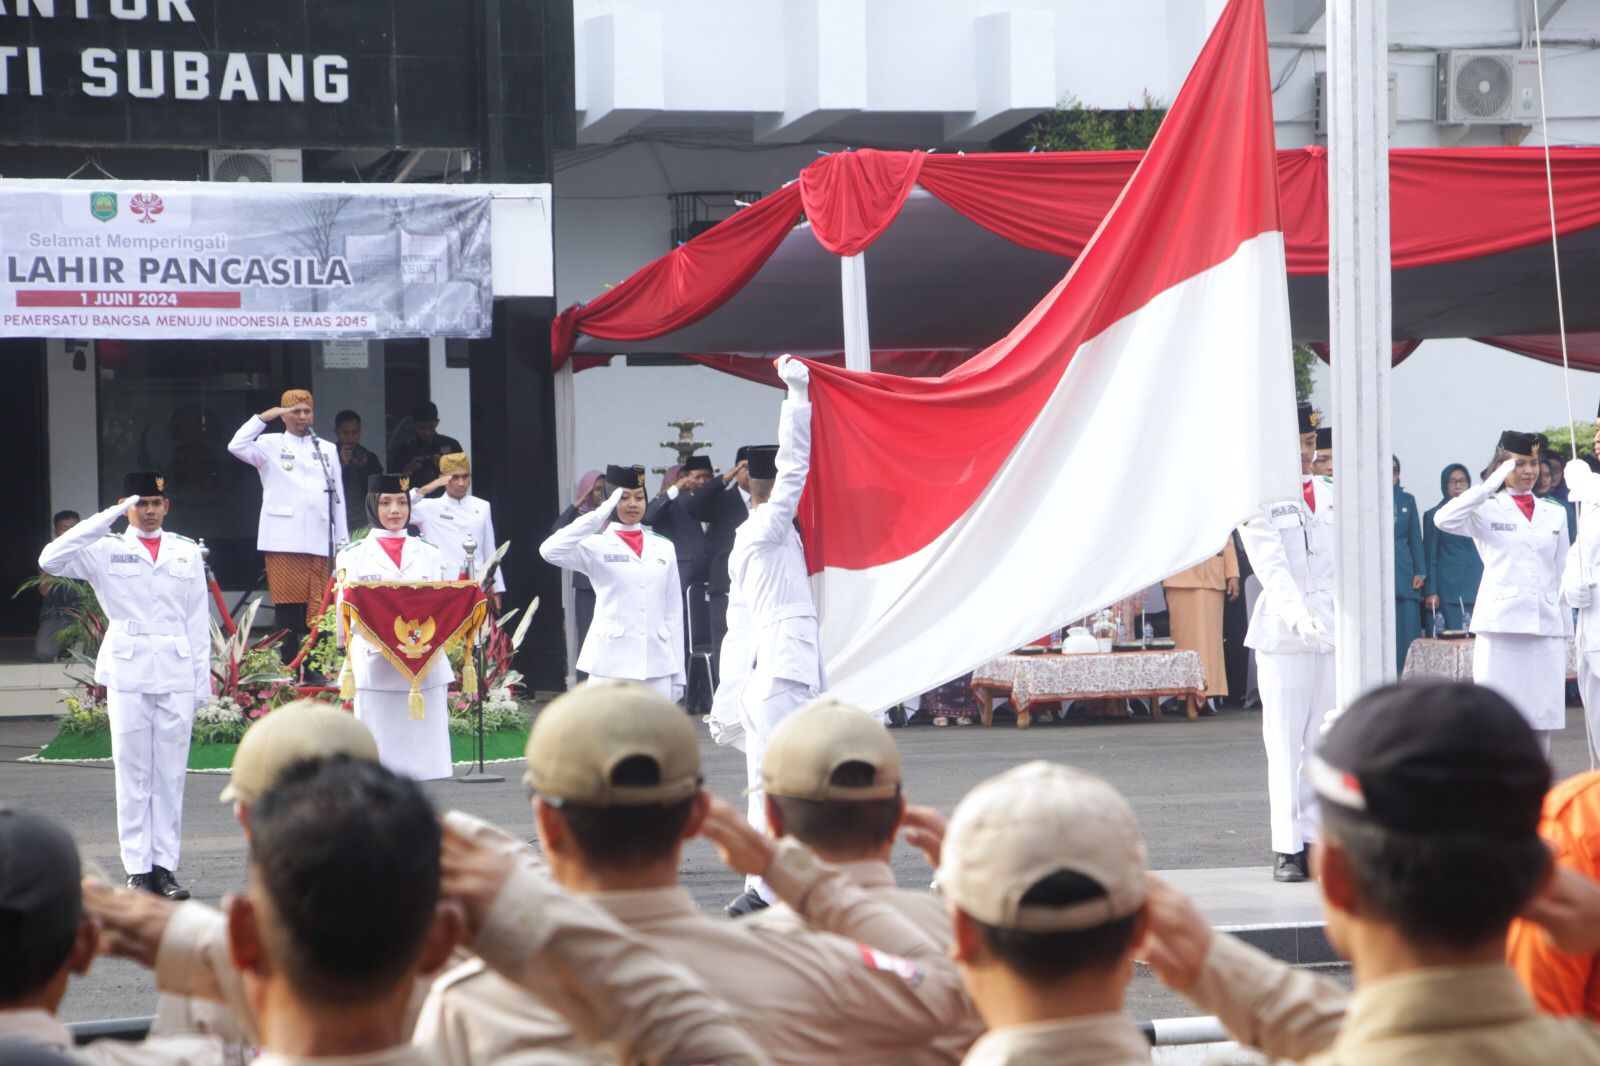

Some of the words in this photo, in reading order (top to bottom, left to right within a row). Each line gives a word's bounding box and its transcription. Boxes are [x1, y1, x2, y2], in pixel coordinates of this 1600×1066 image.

[81, 47, 349, 103] SUBANG
[29, 233, 101, 248] Selamat
[107, 234, 226, 252] Memperingati
[8, 256, 125, 284] LAHIR
[139, 257, 352, 286] PANCASILA
[80, 293, 88, 305] 1
[94, 293, 133, 306] JUNI
[138, 293, 178, 306] 2024
[4, 314, 88, 327] PEMERSATU
[92, 315, 151, 327] BANGSA
[156, 315, 212, 327] MENUJU
[216, 315, 290, 328] INDONESIA
[293, 316, 332, 328] EMAS
[336, 316, 368, 328] 2045
